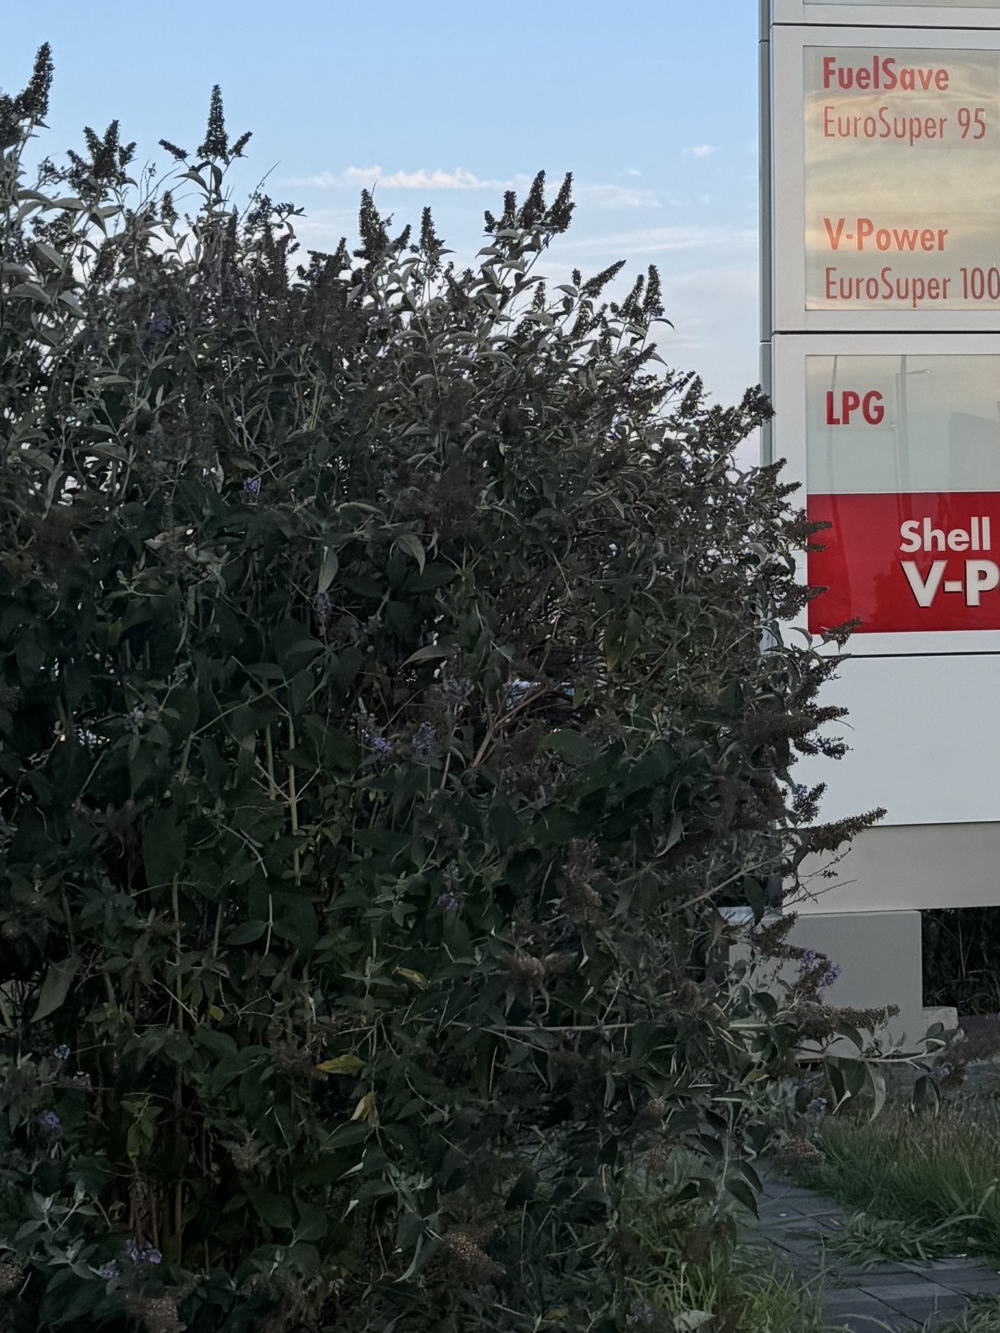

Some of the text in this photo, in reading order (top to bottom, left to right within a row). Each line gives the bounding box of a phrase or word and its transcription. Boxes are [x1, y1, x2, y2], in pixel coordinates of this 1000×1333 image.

[822, 56, 950, 91] FuelSave
[823, 107, 987, 147] EuroSuper 95
[823, 218, 949, 252] V-Power
[824, 266, 951, 308] EuroSuper
[825, 390, 886, 426] LPG
[899, 516, 992, 553] Shell
